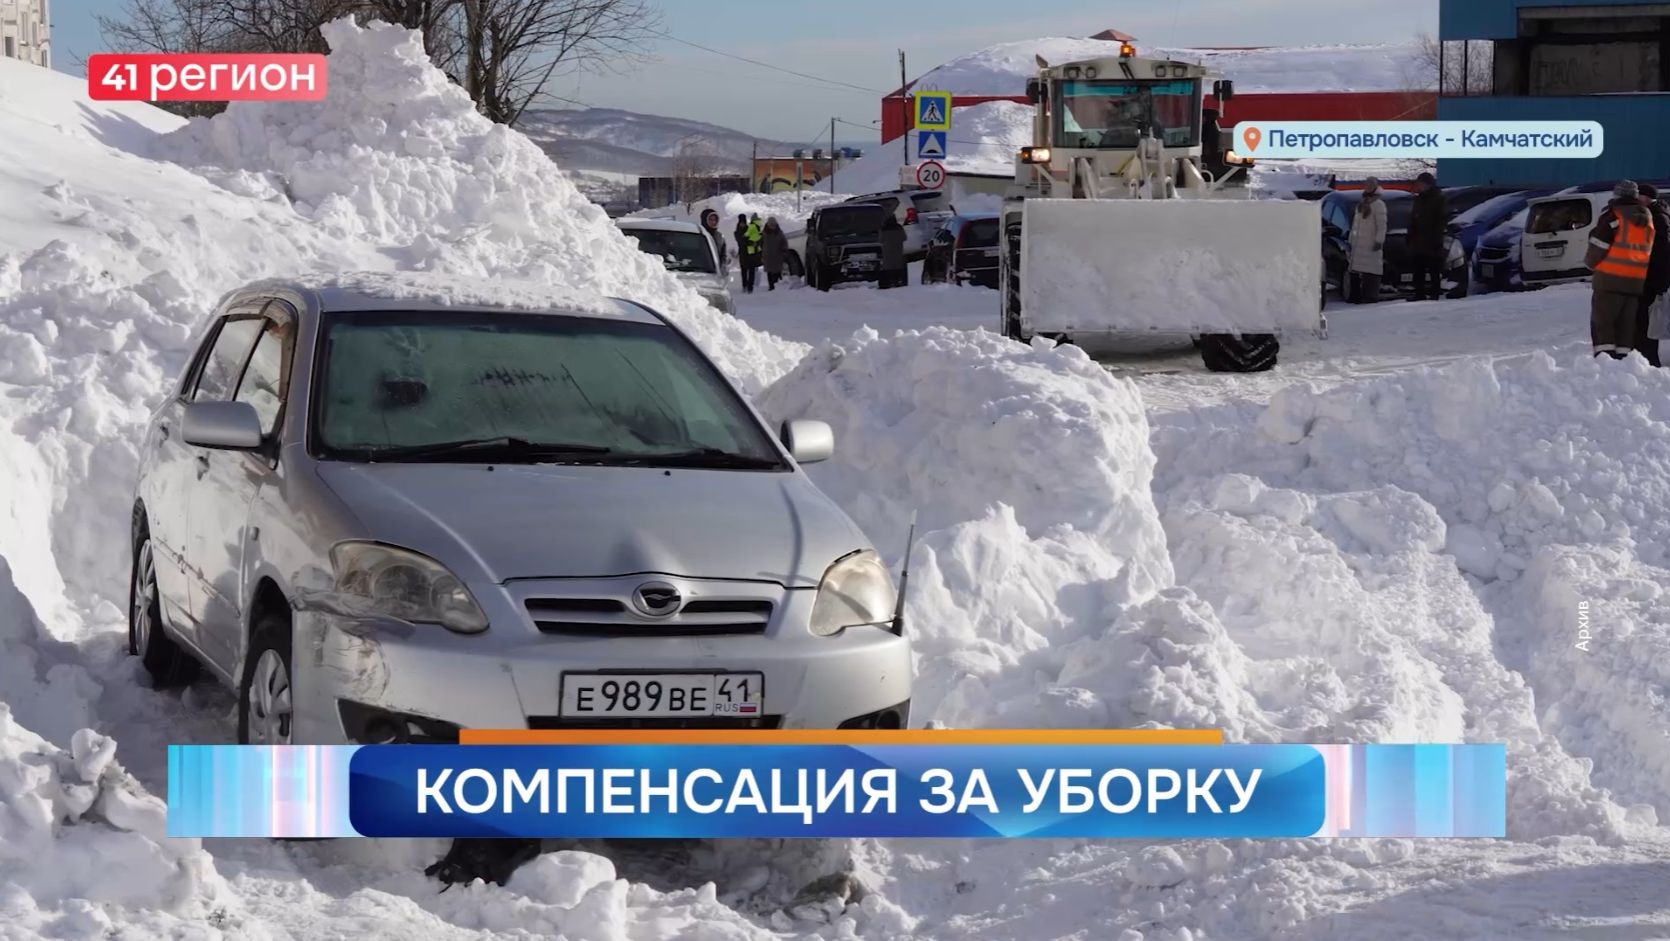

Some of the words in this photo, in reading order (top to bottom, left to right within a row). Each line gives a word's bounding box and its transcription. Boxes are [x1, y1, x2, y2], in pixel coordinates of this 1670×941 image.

[923, 170, 940, 182] 20
[718, 678, 750, 702] 41
[715, 703, 738, 713] RUS
